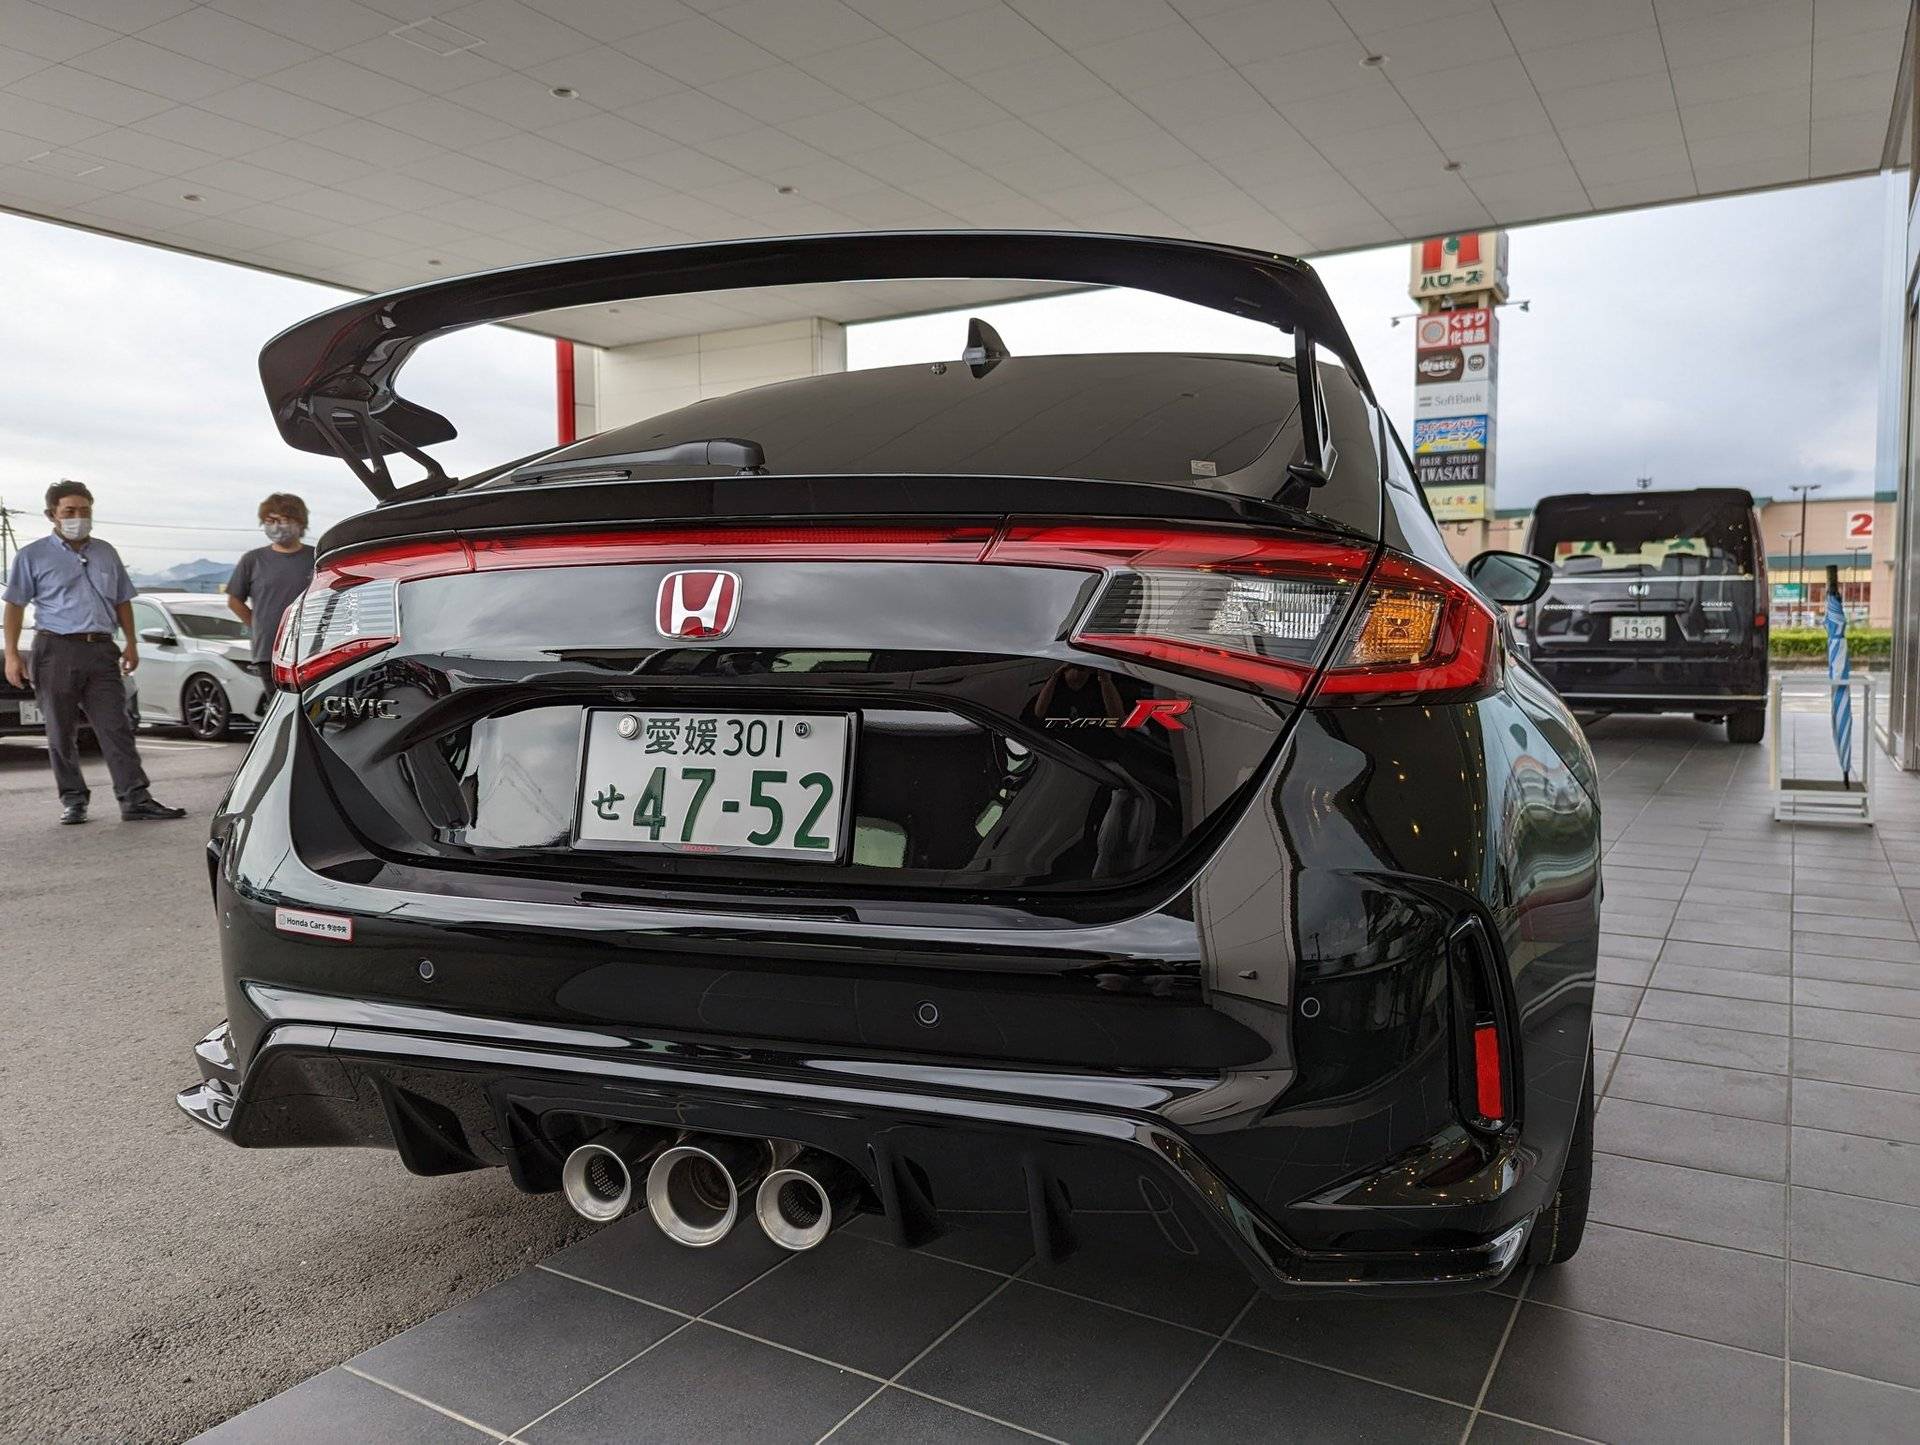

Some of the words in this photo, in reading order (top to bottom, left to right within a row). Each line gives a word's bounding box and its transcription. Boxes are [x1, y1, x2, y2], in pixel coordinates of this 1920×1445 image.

[1421, 271, 1484, 290] ハローズ
[1451, 311, 1486, 327] くすり
[1434, 393, 1482, 406] SoftBank
[1415, 429, 1485, 445] クリーニング
[1420, 456, 1441, 467] HAIR
[1447, 454, 1478, 465] STUDIO
[1420, 465, 1479, 482] IWASAKI
[1851, 513, 1873, 536] 2
[1624, 626, 1662, 639] 19-09
[324, 695, 402, 719] CIVIC
[1044, 718, 1119, 729] TYPE
[1121, 699, 1192, 730] R
[633, 766, 834, 849] 47-52
[681, 843, 721, 853] HONDA
[287, 917, 308, 927] Honda
[310, 921, 326, 930] Cars
